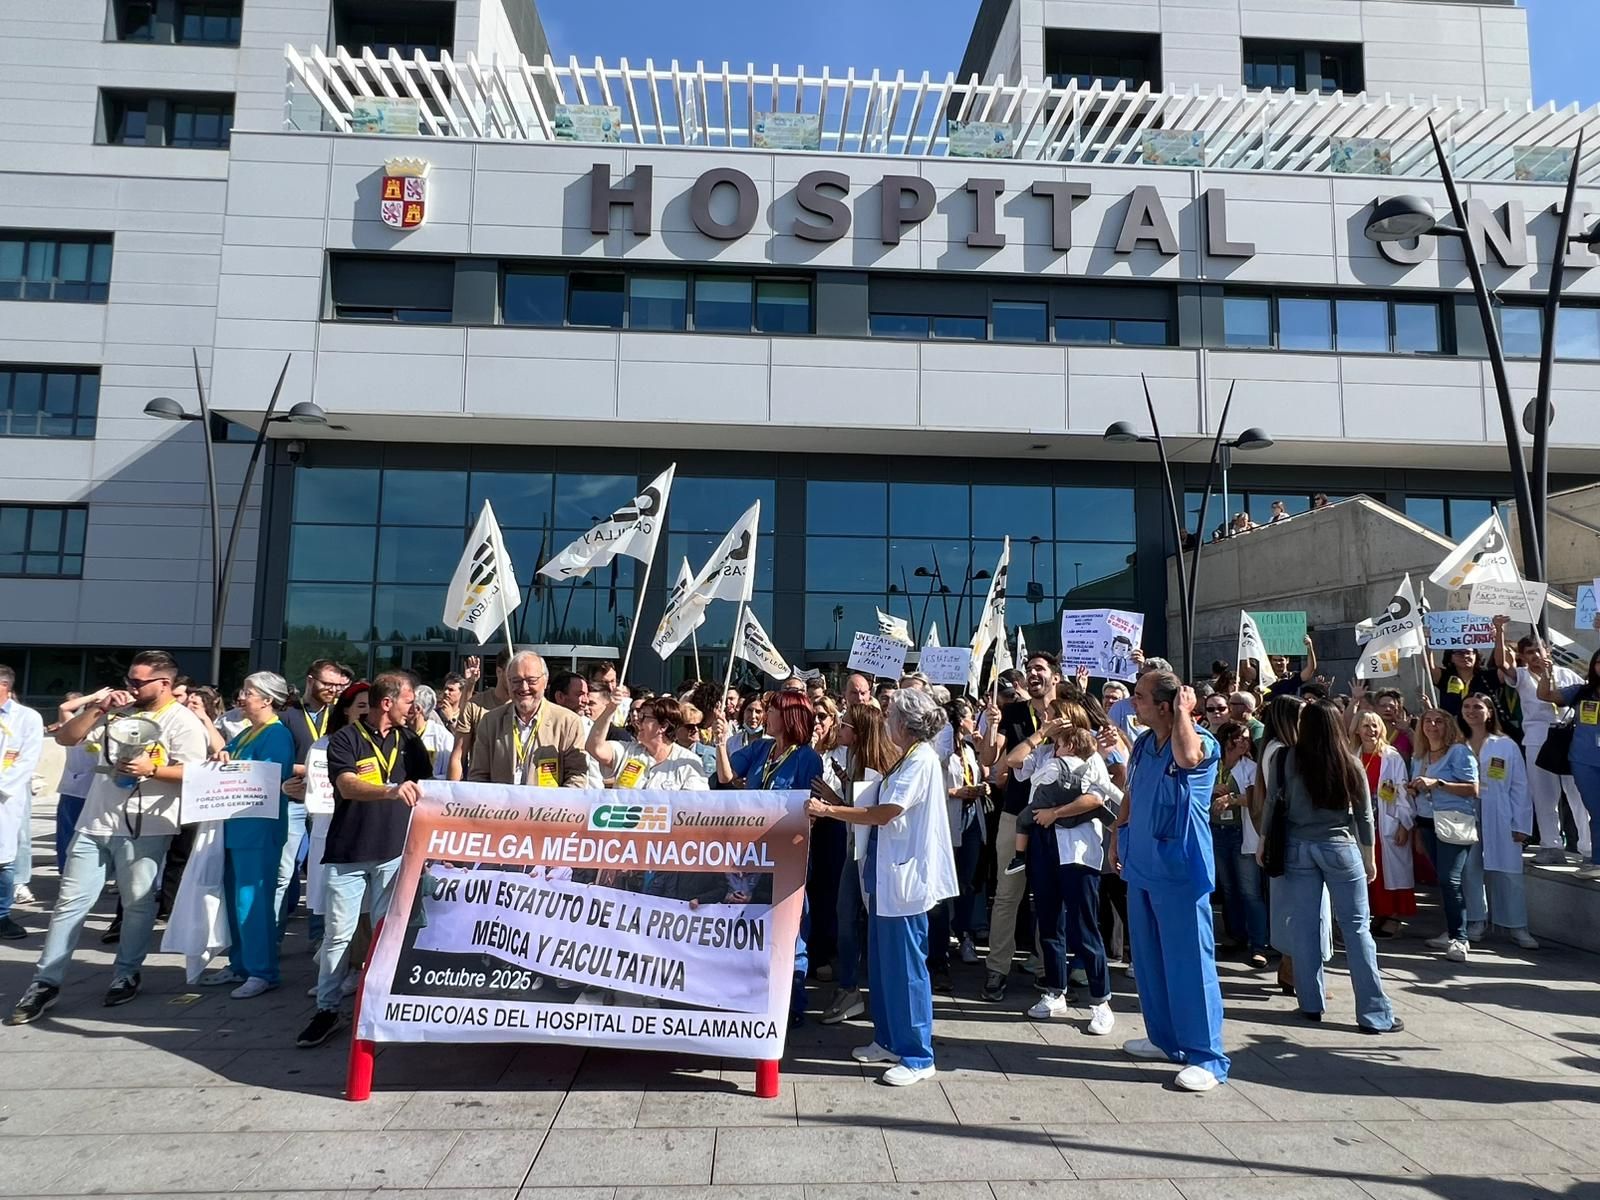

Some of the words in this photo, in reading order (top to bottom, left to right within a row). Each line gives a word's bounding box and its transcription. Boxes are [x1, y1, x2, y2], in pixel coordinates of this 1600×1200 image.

[589, 163, 1256, 258] HOSPITAL
[440, 802, 520, 821] Sindicato
[524, 806, 586, 824] Médico
[592, 804, 668, 831] CESM
[673, 810, 766, 827] Salamanca
[427, 830, 534, 860] HUELGA
[540, 832, 639, 864] MÉDICA
[645, 839, 775, 867] NACIONAL
[464, 879, 493, 905] UN
[495, 880, 584, 923] ESTATUTO
[586, 897, 616, 929] DE
[615, 904, 642, 935] LA
[646, 910, 765, 951] PROFESIÓN
[471, 916, 531, 960] MÉDICA
[535, 934, 552, 963] Y
[550, 938, 685, 992] FACULTATIVA
[409, 965, 422, 984] 3
[424, 967, 486, 988] octubre
[489, 969, 532, 991] 2025
[385, 1002, 489, 1026] MEDICO/AS
[494, 1008, 530, 1028] DEL
[535, 1010, 626, 1034] HOSPITAL
[631, 1015, 657, 1035] DE
[662, 1016, 778, 1040] SALAMANCA
